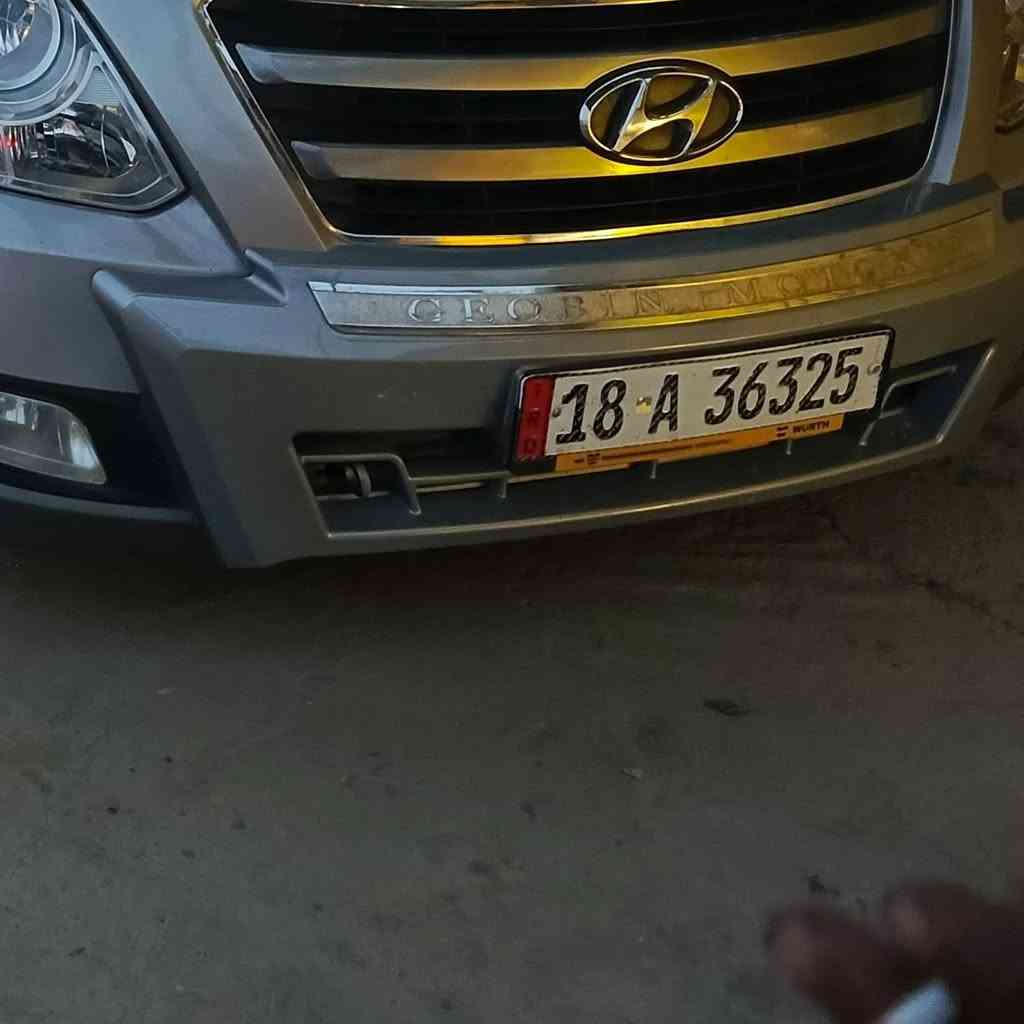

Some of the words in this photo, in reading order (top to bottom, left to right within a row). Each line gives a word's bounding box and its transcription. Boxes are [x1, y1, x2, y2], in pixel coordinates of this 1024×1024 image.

[556, 379, 628, 445] 18
[647, 373, 680, 435] A
[704, 346, 863, 426] 36325
